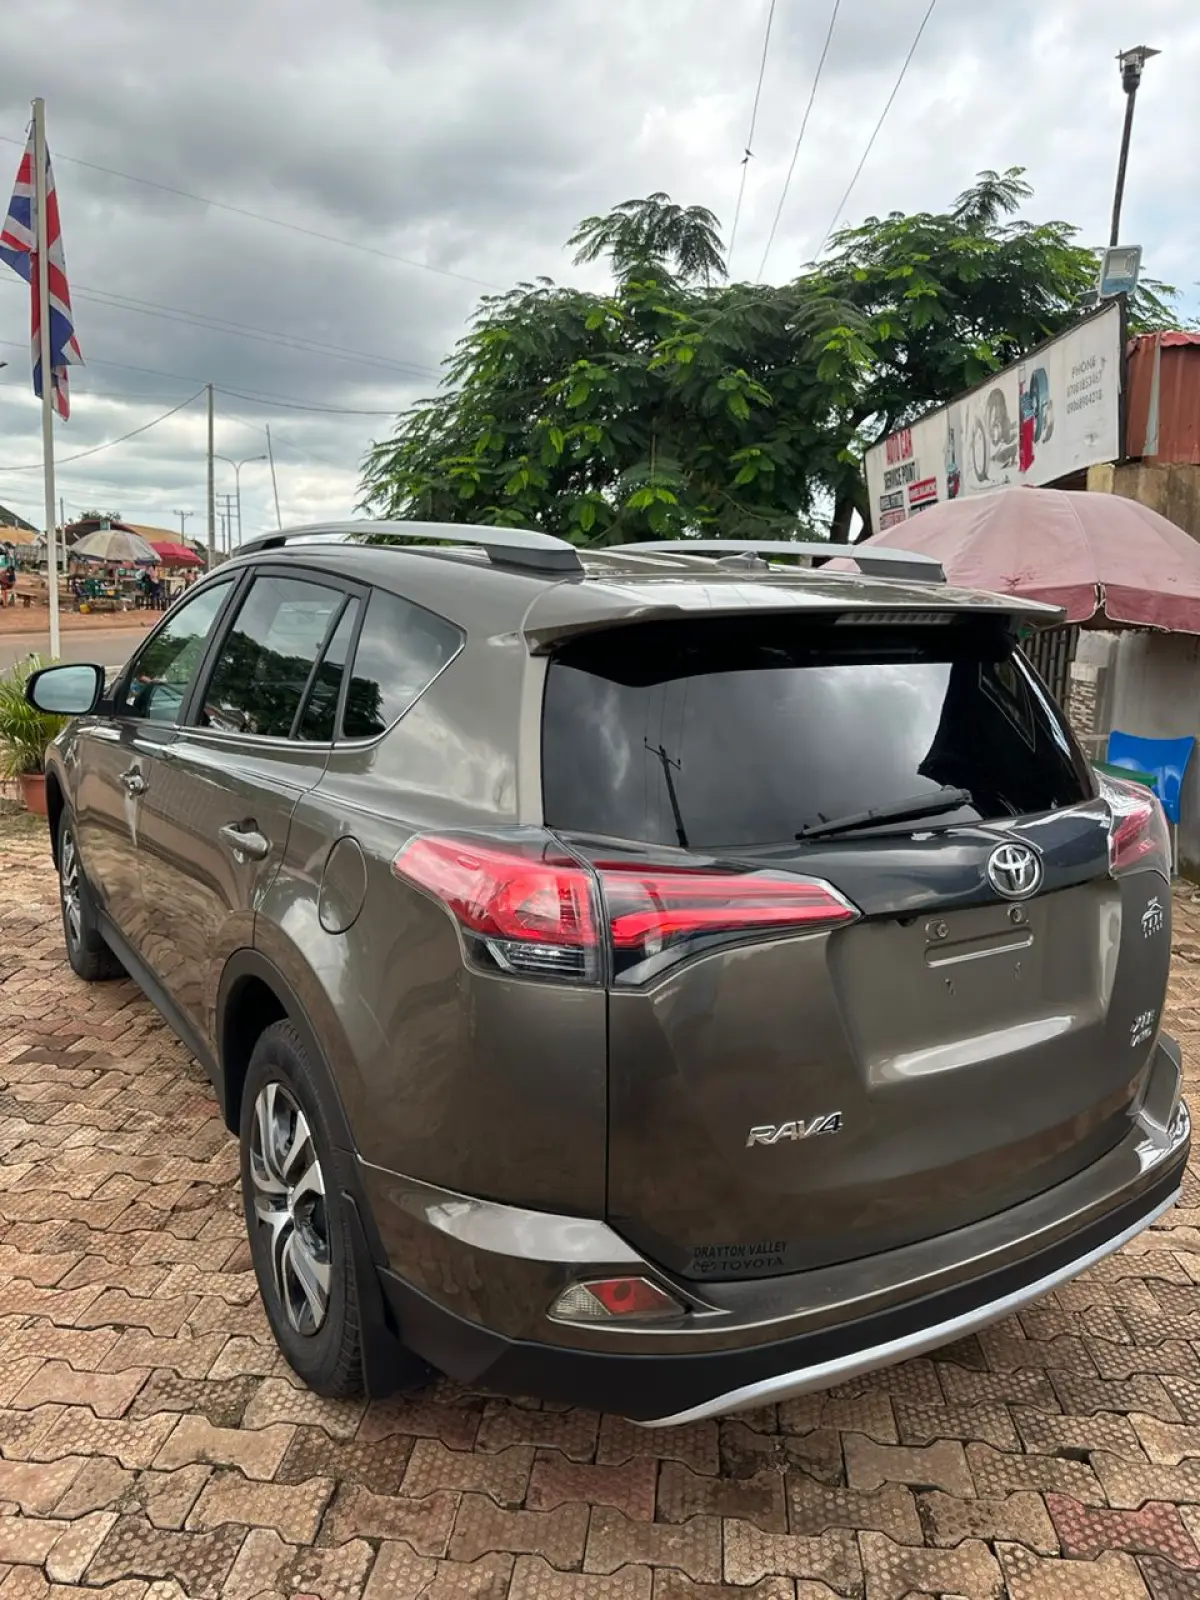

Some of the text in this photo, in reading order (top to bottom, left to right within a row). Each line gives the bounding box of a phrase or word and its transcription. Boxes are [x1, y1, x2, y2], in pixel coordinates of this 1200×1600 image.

[745, 1111, 843, 1148] RAV4
[694, 1240, 787, 1259] DRAYTON VALLEY
[721, 1256, 785, 1271] TOYOTA
